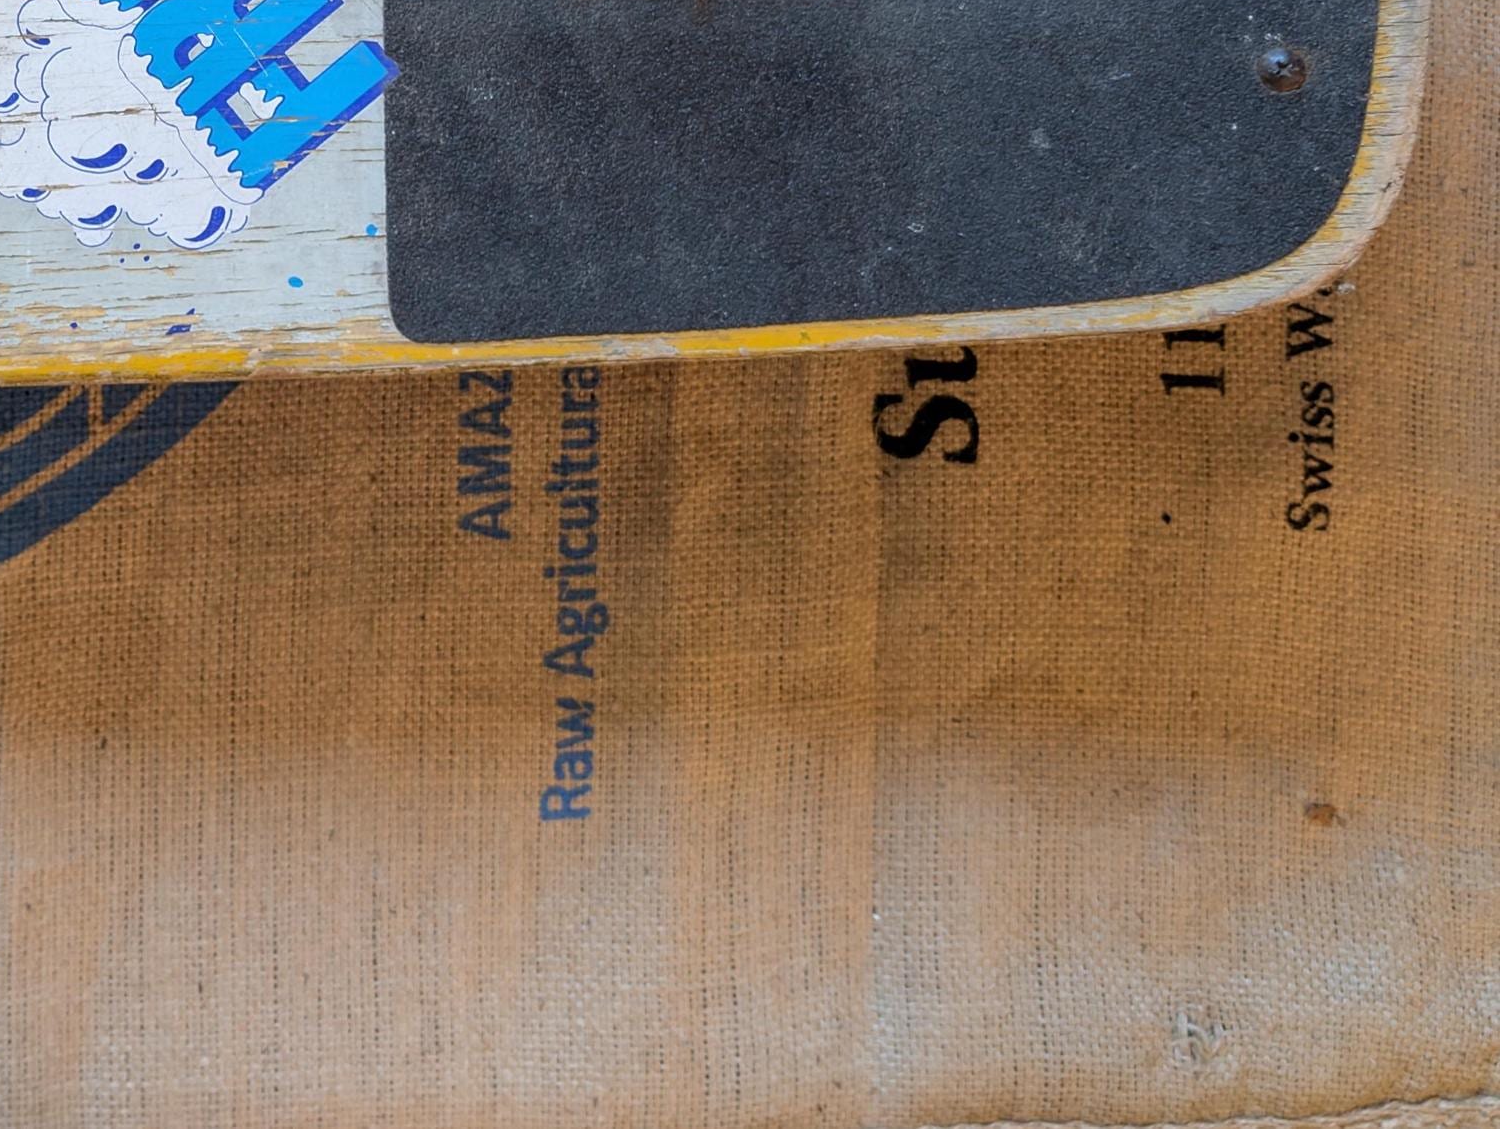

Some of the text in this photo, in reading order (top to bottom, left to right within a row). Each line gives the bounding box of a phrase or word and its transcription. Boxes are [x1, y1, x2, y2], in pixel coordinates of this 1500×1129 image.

[457, 369, 514, 542] AMAZ
[872, 346, 980, 464] Su
[1286, 380, 1335, 532] Swiss
[539, 366, 610, 822] Raw Agricultura
